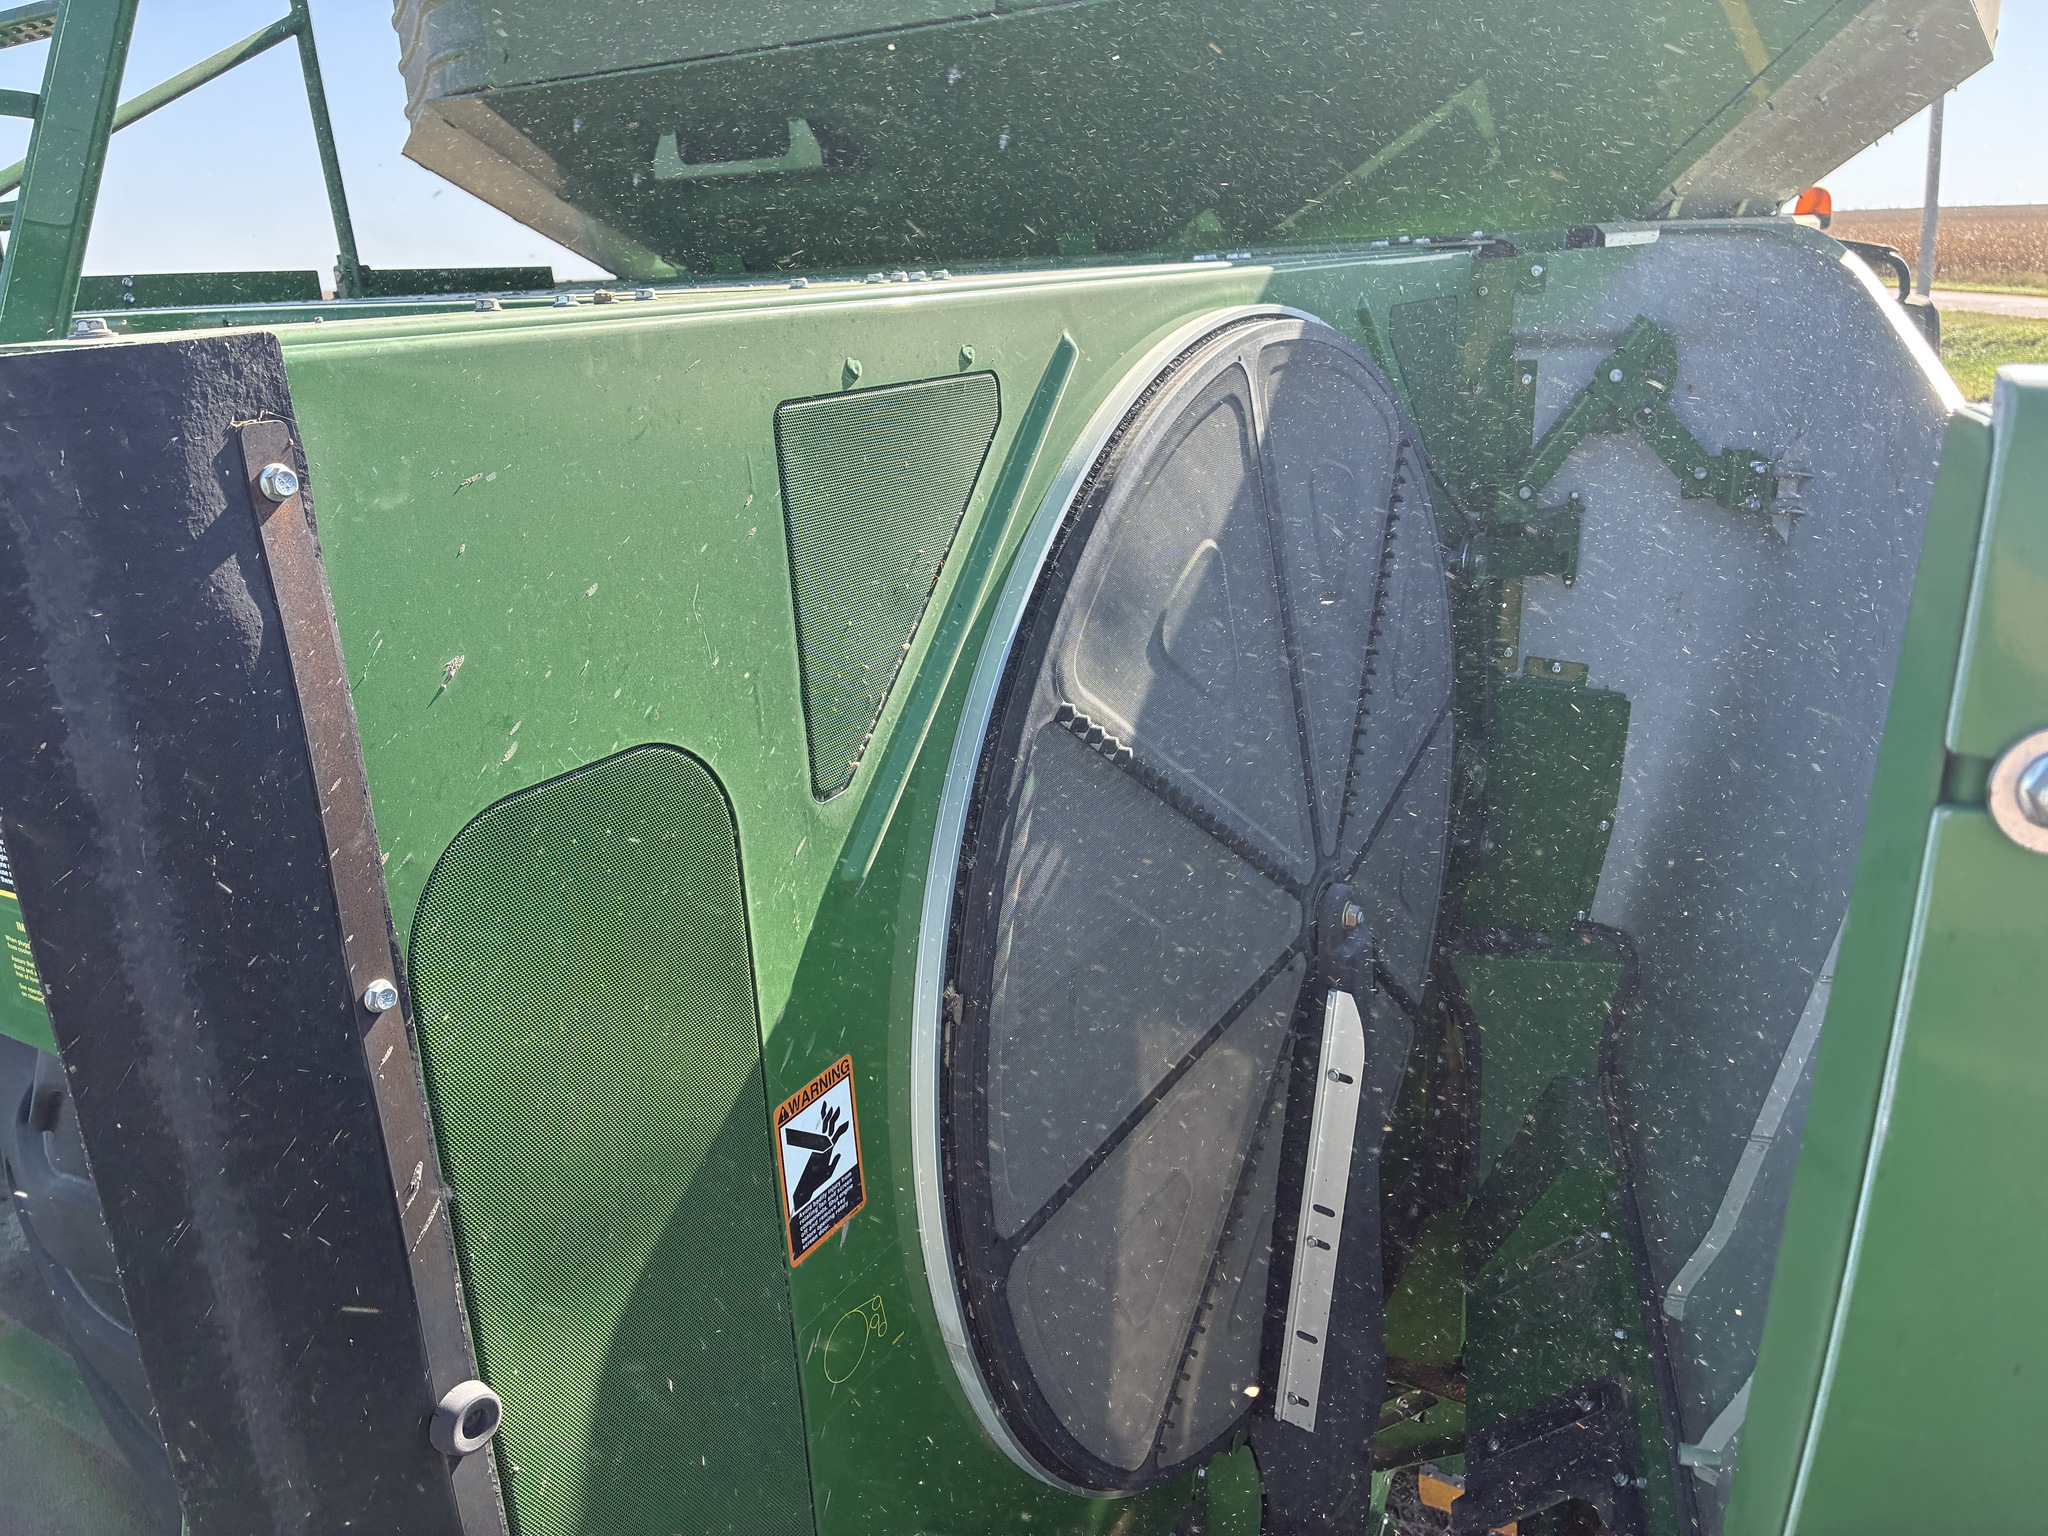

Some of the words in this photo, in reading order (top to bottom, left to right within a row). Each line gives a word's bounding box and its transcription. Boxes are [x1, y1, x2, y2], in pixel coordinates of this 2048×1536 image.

[788, 1058, 850, 1114] WARNING
[799, 1204, 812, 1219] Avoid
[813, 1193, 827, 1206] bodily
[828, 1181, 840, 1194] injury
[841, 1172, 852, 1183] from
[800, 1207, 818, 1225] rotating
[819, 1200, 827, 1209] fan
[828, 1191, 836, 1201] and
[837, 1178, 852, 1193] screen
[800, 1207, 828, 1231] components.
[828, 1196, 839, 1207] Shut
[839, 1184, 853, 1198] engine
[809, 1220, 818, 1231] and
[819, 1204, 836, 1222] remove
[837, 1196, 846, 1207] key
[802, 1229, 816, 1244] before
[817, 1212, 835, 1230] opening
[836, 1201, 849, 1214] rotary
[802, 1234, 818, 1250] screen
[819, 1224, 830, 1236] door.
